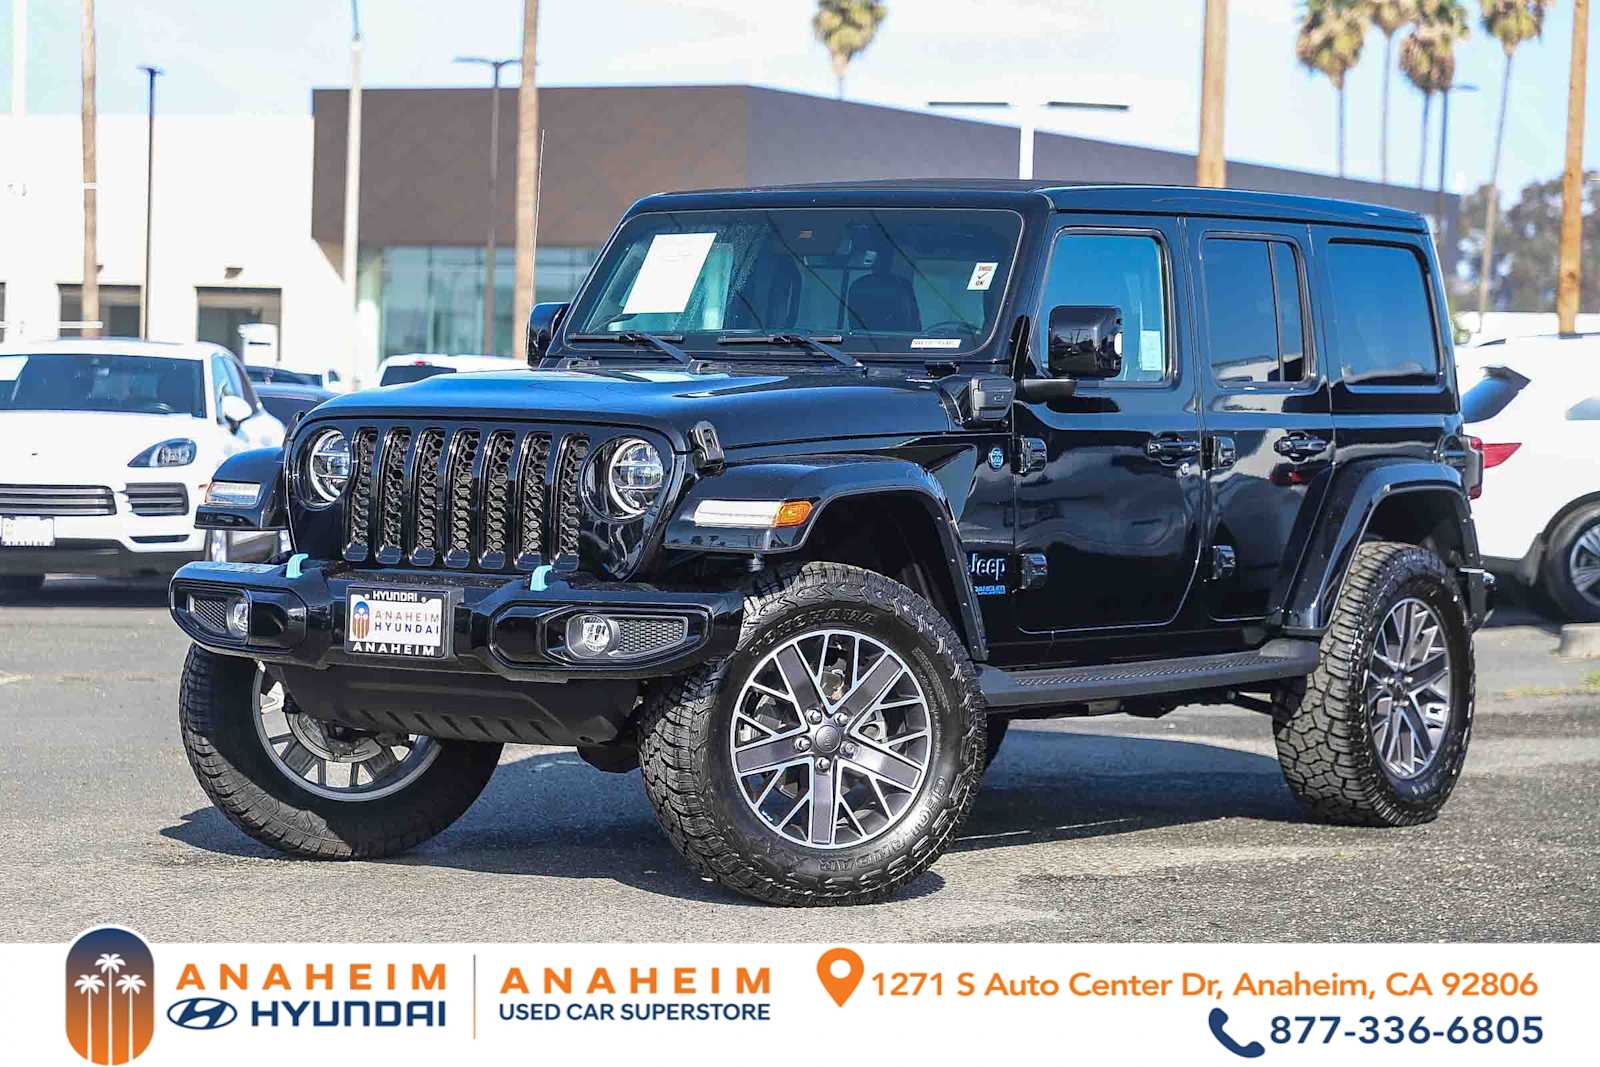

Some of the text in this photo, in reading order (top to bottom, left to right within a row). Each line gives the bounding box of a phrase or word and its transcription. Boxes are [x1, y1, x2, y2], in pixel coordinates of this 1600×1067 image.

[970, 553, 1006, 581] Jeep
[372, 590, 418, 603] HYUNDAI
[374, 609, 440, 623] ANAHEIM
[374, 622, 439, 635] HYUNDAI
[352, 641, 435, 656] ANAHEIM
